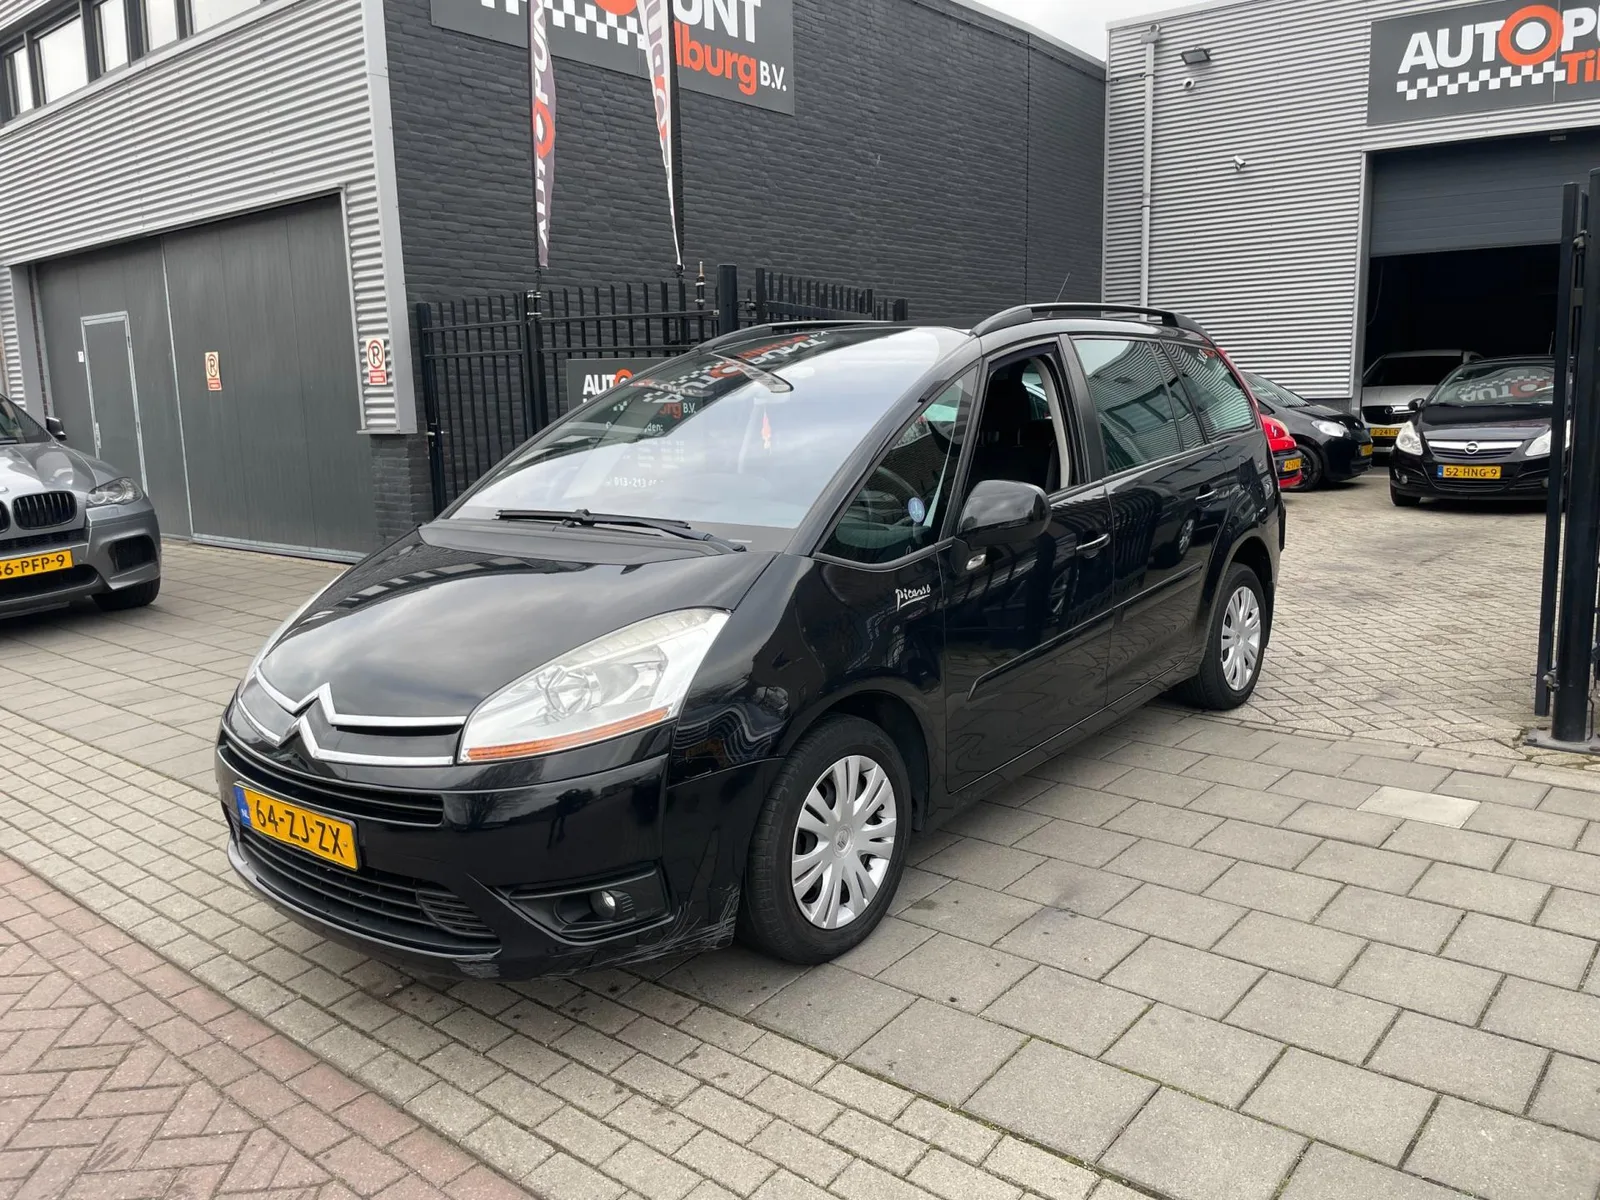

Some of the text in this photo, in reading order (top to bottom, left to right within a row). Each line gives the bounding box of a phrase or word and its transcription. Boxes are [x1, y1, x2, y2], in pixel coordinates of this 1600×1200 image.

[1397, 5, 1600, 74] AUTOP
[760, 60, 787, 92] B.V.
[682, 402, 697, 414] B.V.
[1445, 467, 1497, 477] 52-HNG-9
[895, 584, 931, 612] Picasso
[256, 800, 345, 858] 64-ZJ-ZX
